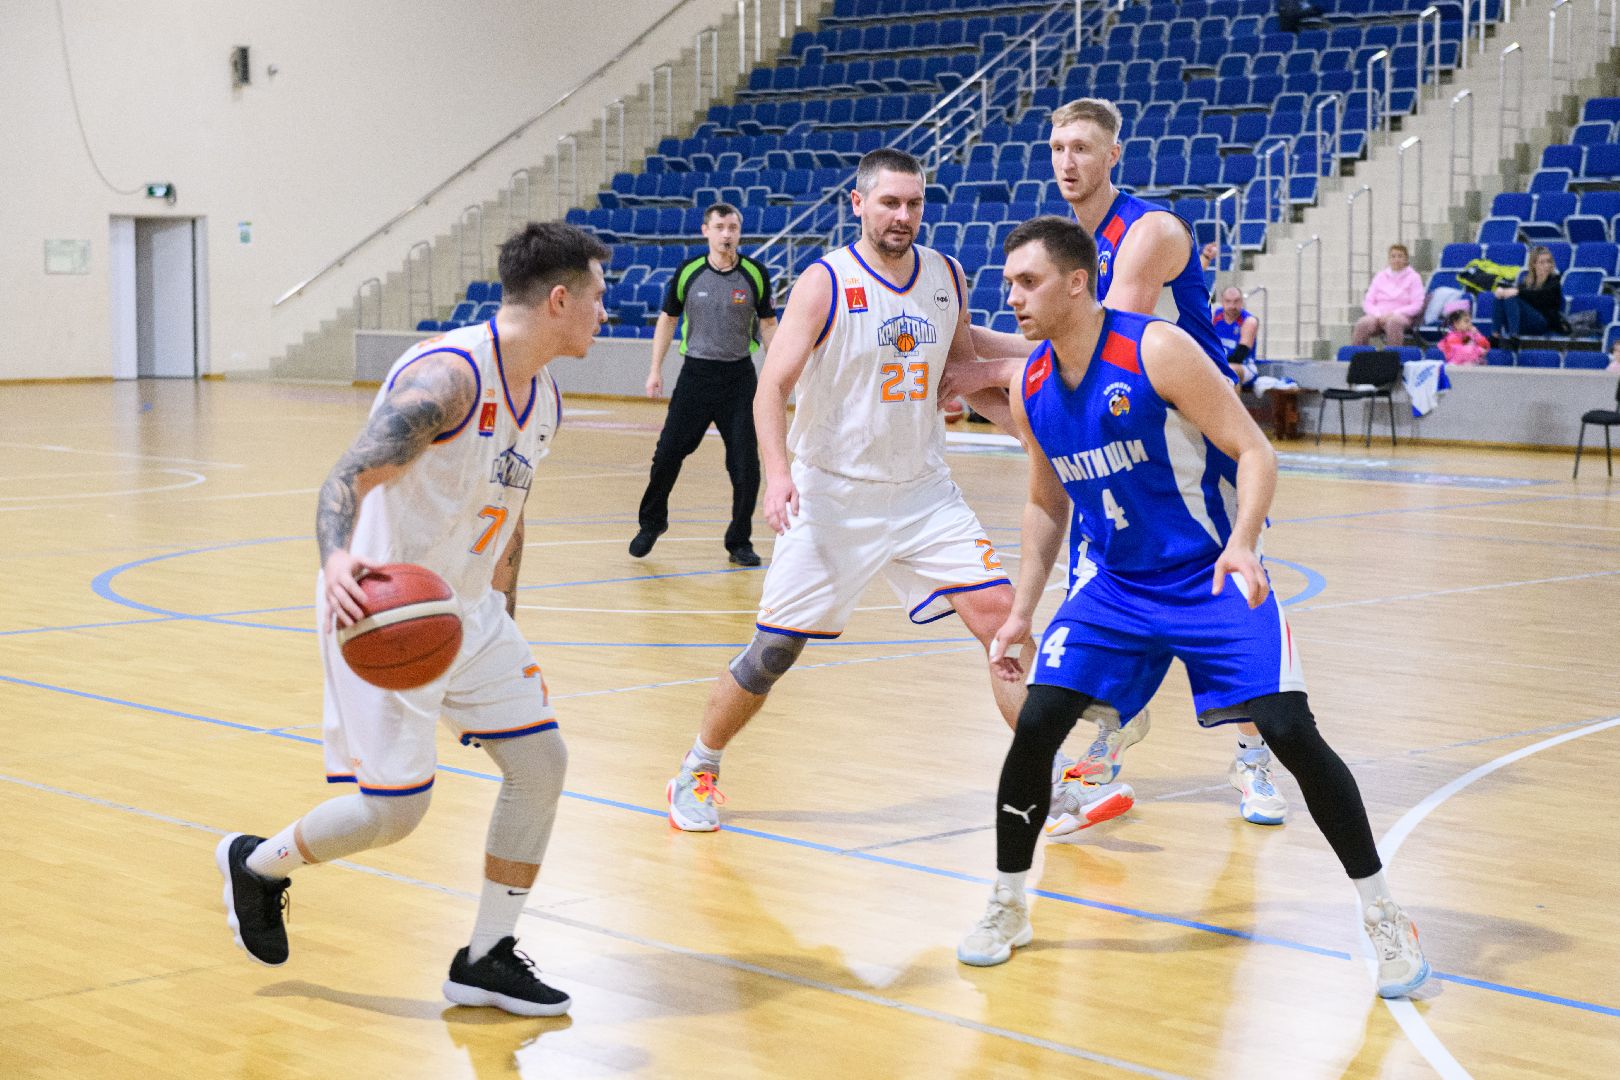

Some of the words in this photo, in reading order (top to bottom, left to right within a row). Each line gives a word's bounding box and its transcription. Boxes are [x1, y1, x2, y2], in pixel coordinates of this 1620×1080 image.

[880, 362, 929, 402] 23
[470, 505, 508, 555] 7
[1102, 488, 1130, 531] 4
[975, 539, 1002, 571] 2
[1041, 626, 1070, 668] 4
[523, 663, 548, 706] 7
